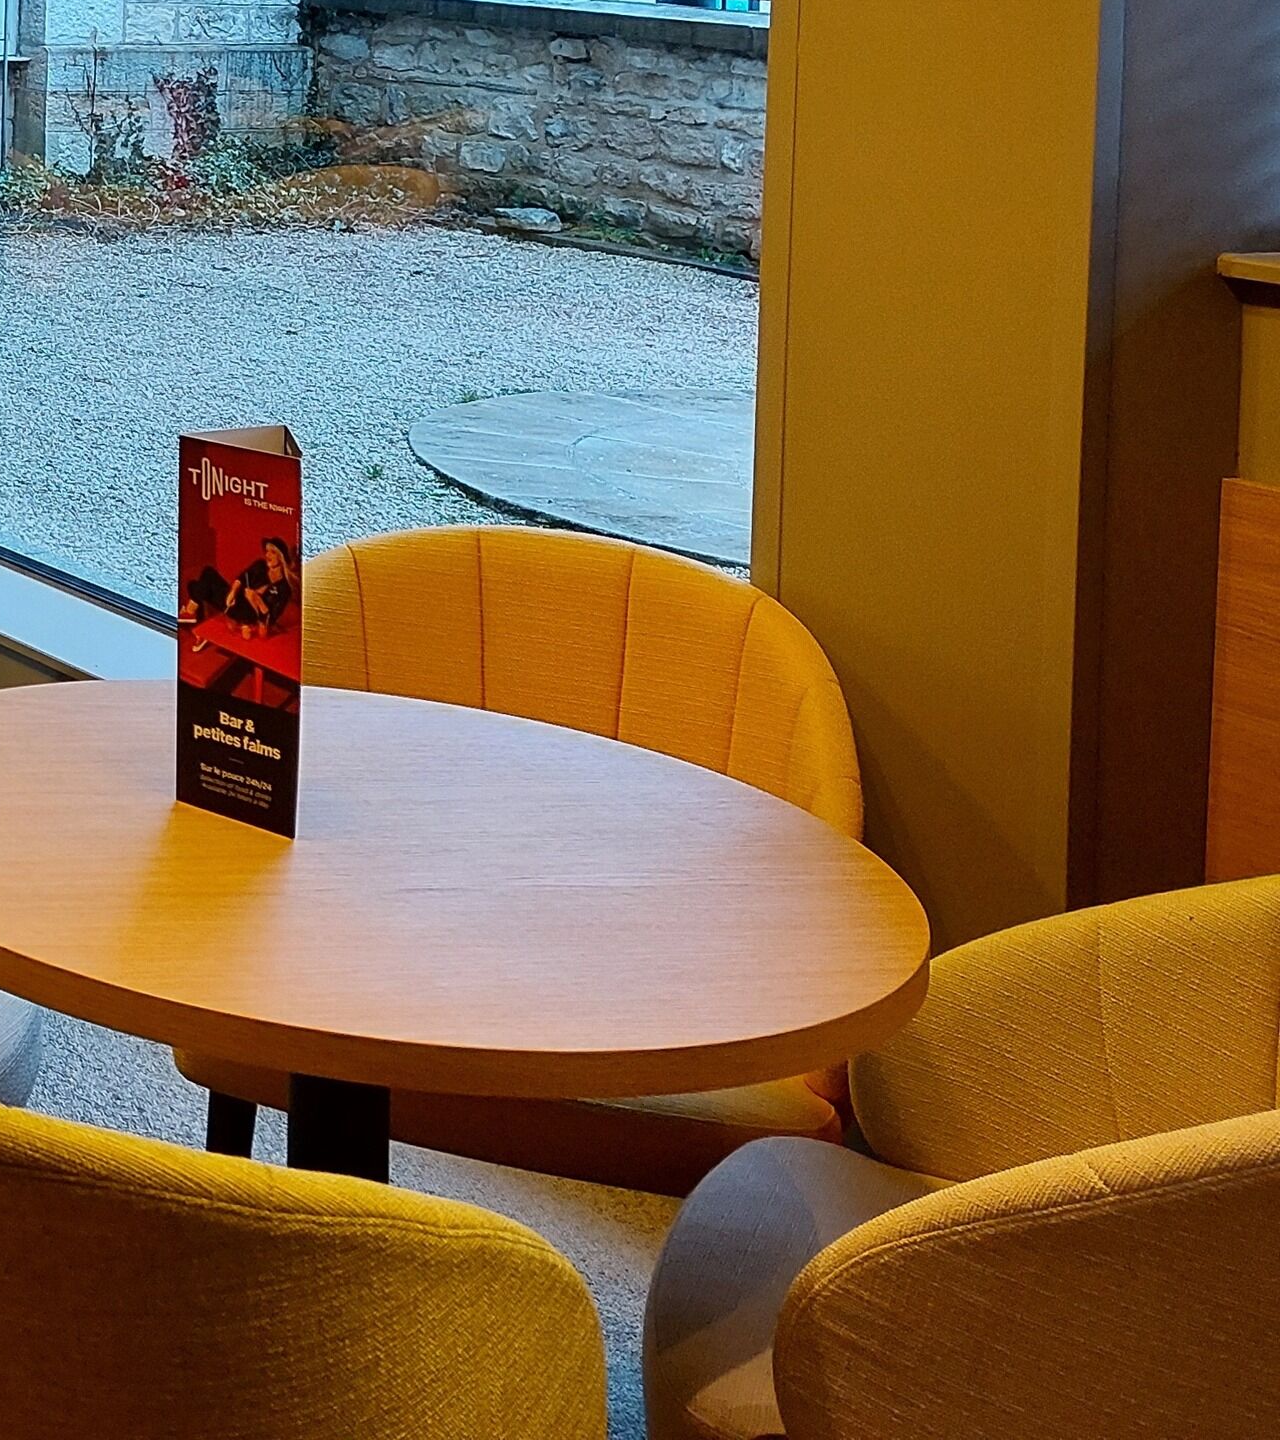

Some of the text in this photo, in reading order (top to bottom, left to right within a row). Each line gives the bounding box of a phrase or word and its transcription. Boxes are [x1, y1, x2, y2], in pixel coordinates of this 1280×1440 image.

[187, 457, 270, 501] TONIGHT
[244, 497, 296, 516] IS THE NIGHT
[219, 710, 256, 734] Bar &
[192, 723, 282, 760] petites faims
[221, 769, 245, 783] pouce
